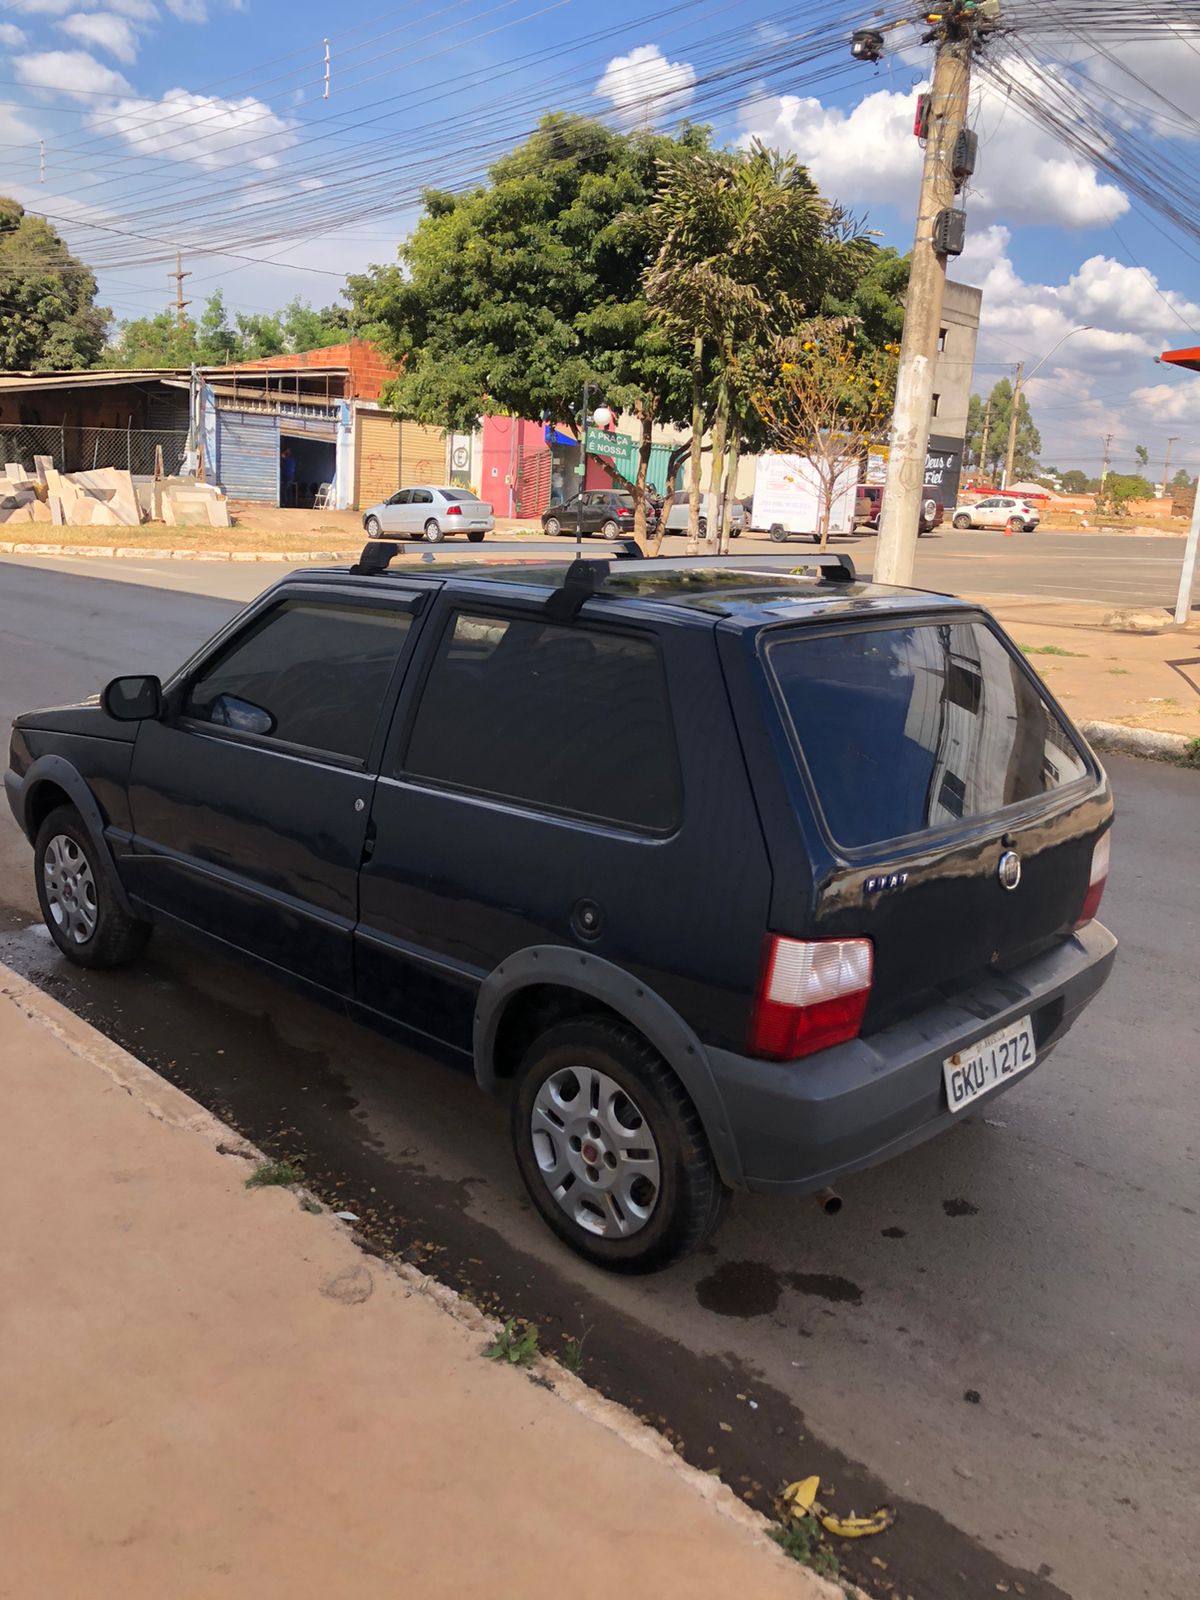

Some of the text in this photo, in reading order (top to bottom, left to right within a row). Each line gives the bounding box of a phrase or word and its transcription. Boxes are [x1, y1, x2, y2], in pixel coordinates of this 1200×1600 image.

[589, 430, 629, 446] A PRAÇA
[588, 440, 627, 457] É NOSSA
[924, 454, 945, 469] Deus
[924, 470, 943, 484] Fiel
[866, 873, 908, 892] FIAT
